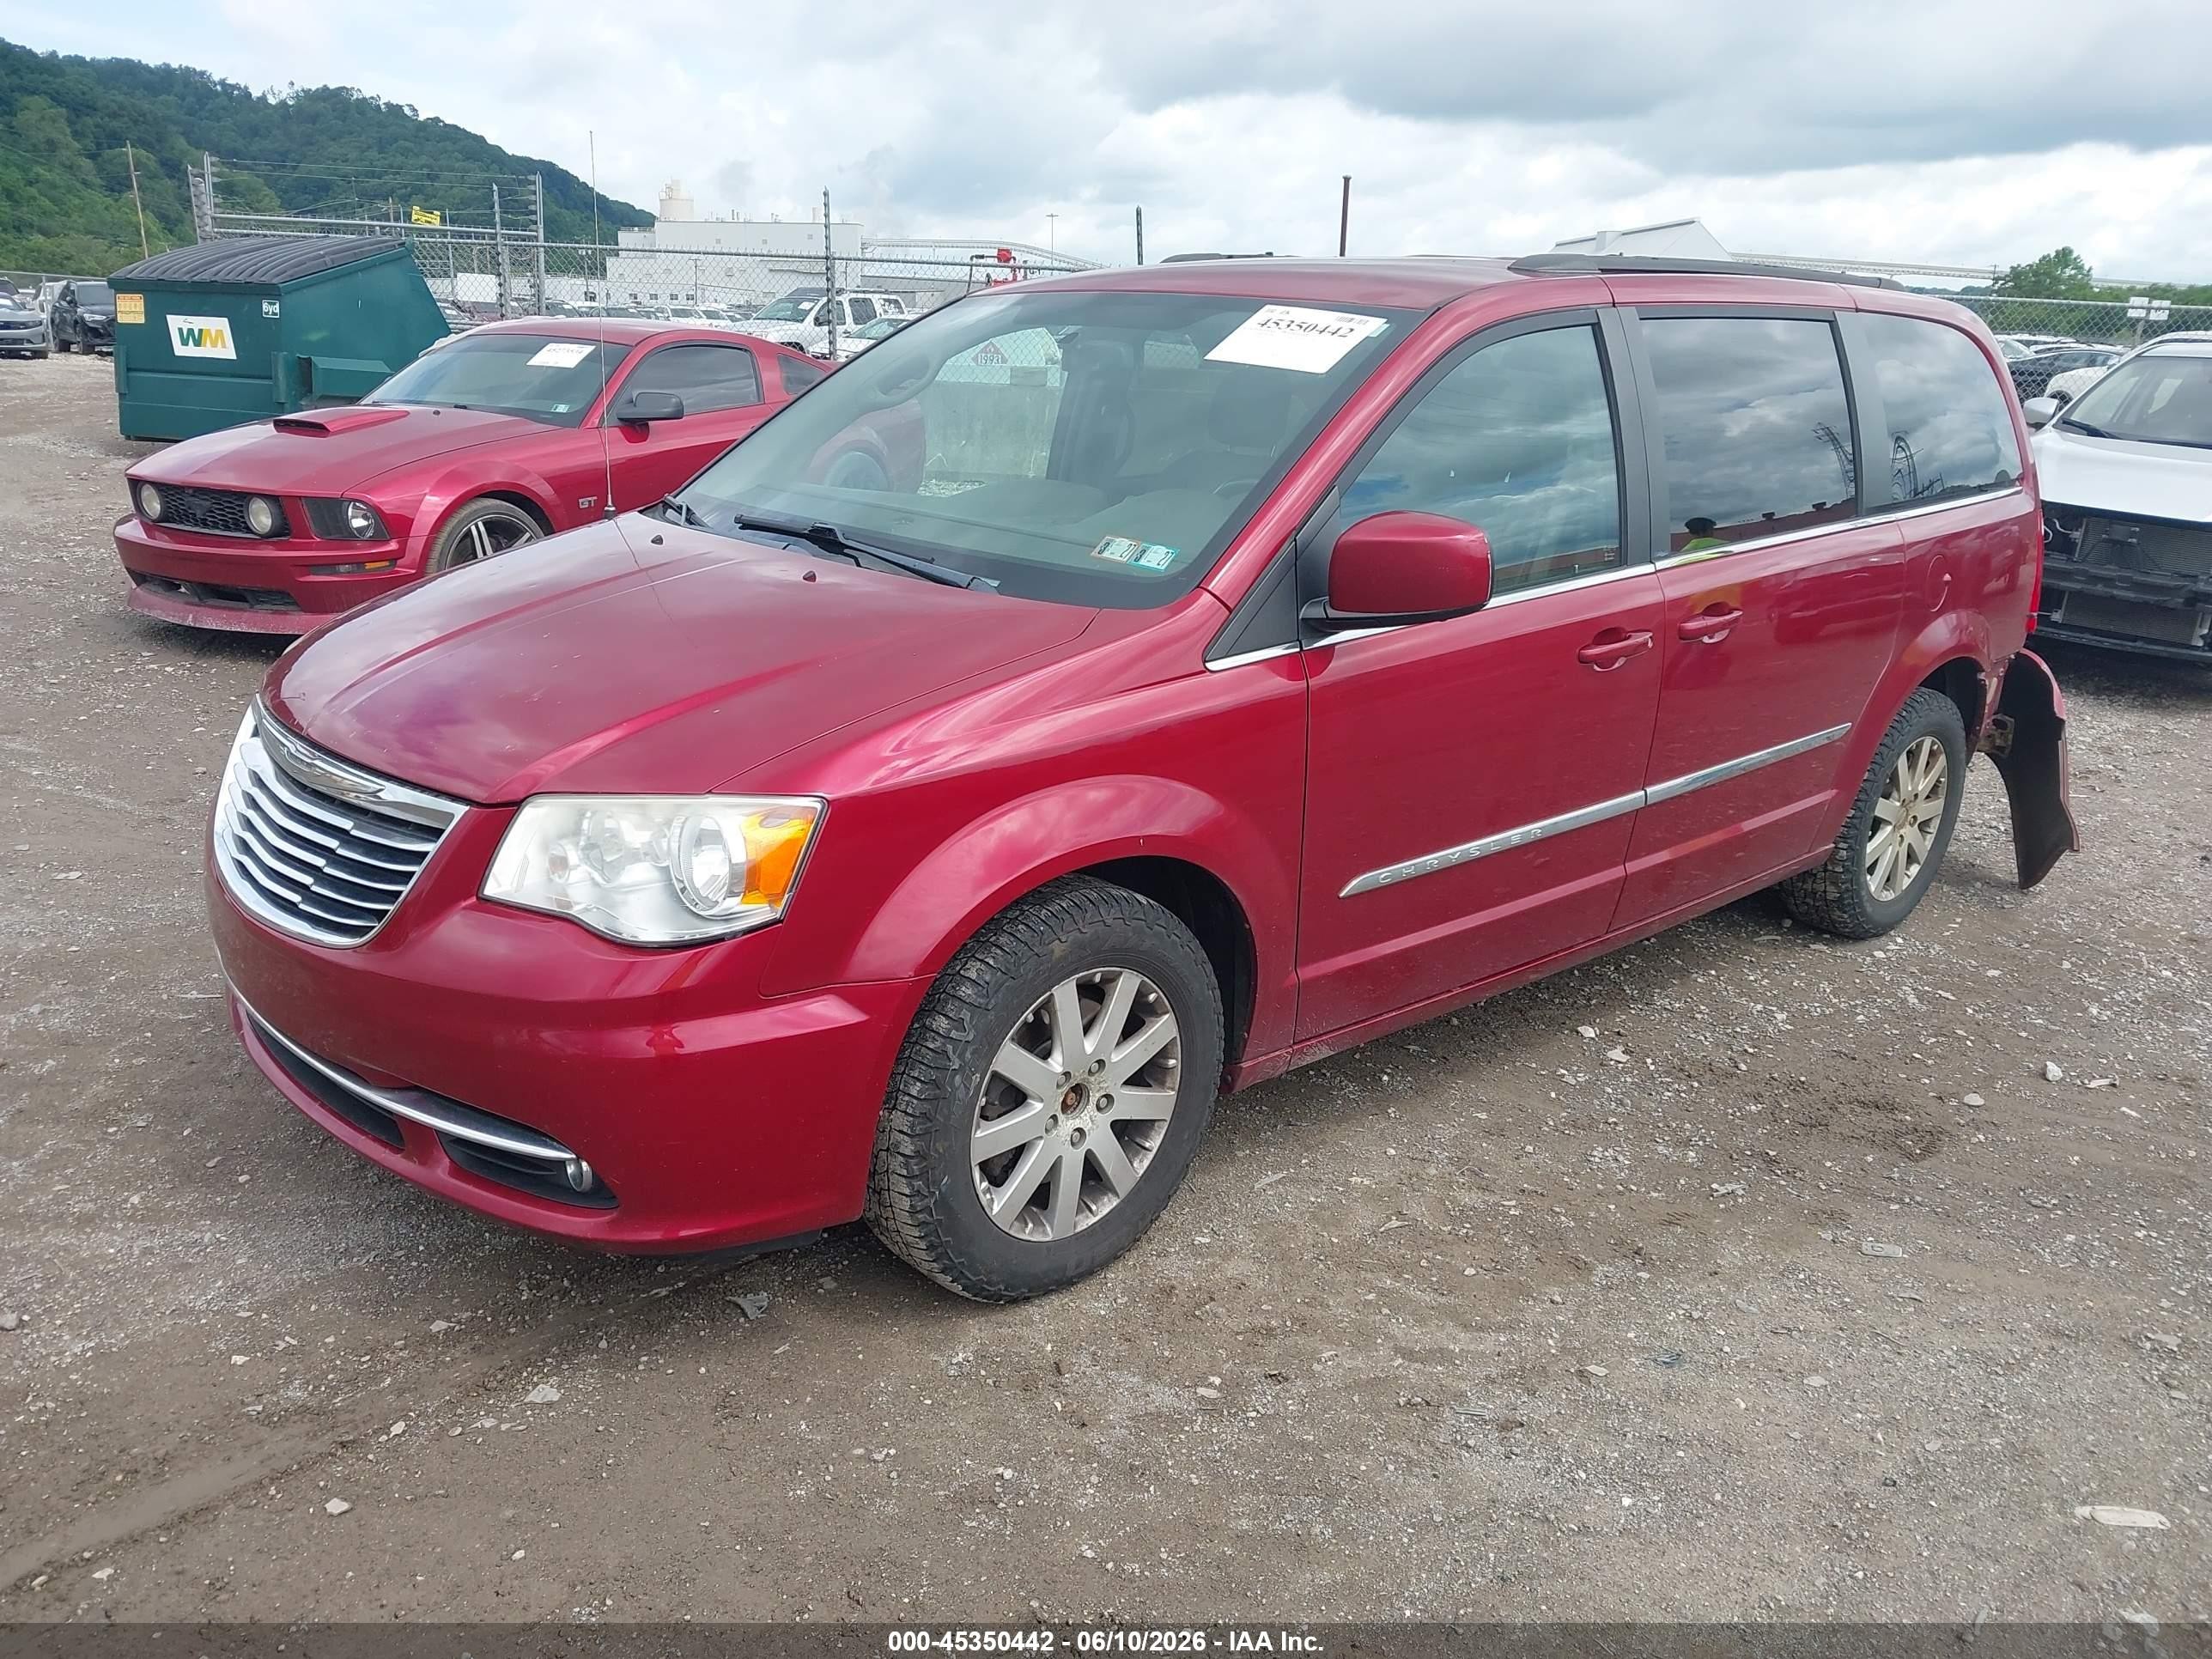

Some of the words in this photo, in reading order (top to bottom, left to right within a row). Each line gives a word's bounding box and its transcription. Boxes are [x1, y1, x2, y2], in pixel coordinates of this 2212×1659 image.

[264, 301, 278, 315] 6yd
[1257, 317, 1355, 337] 45350442
[177, 326, 227, 349] WM
[579, 495, 598, 508] GT
[1097, 542, 1110, 555] 3
[1119, 543, 1137, 560] 27
[1133, 549, 1147, 562] 3
[1157, 550, 1175, 568] 27
[1379, 828, 1542, 884] CHRYSLER
